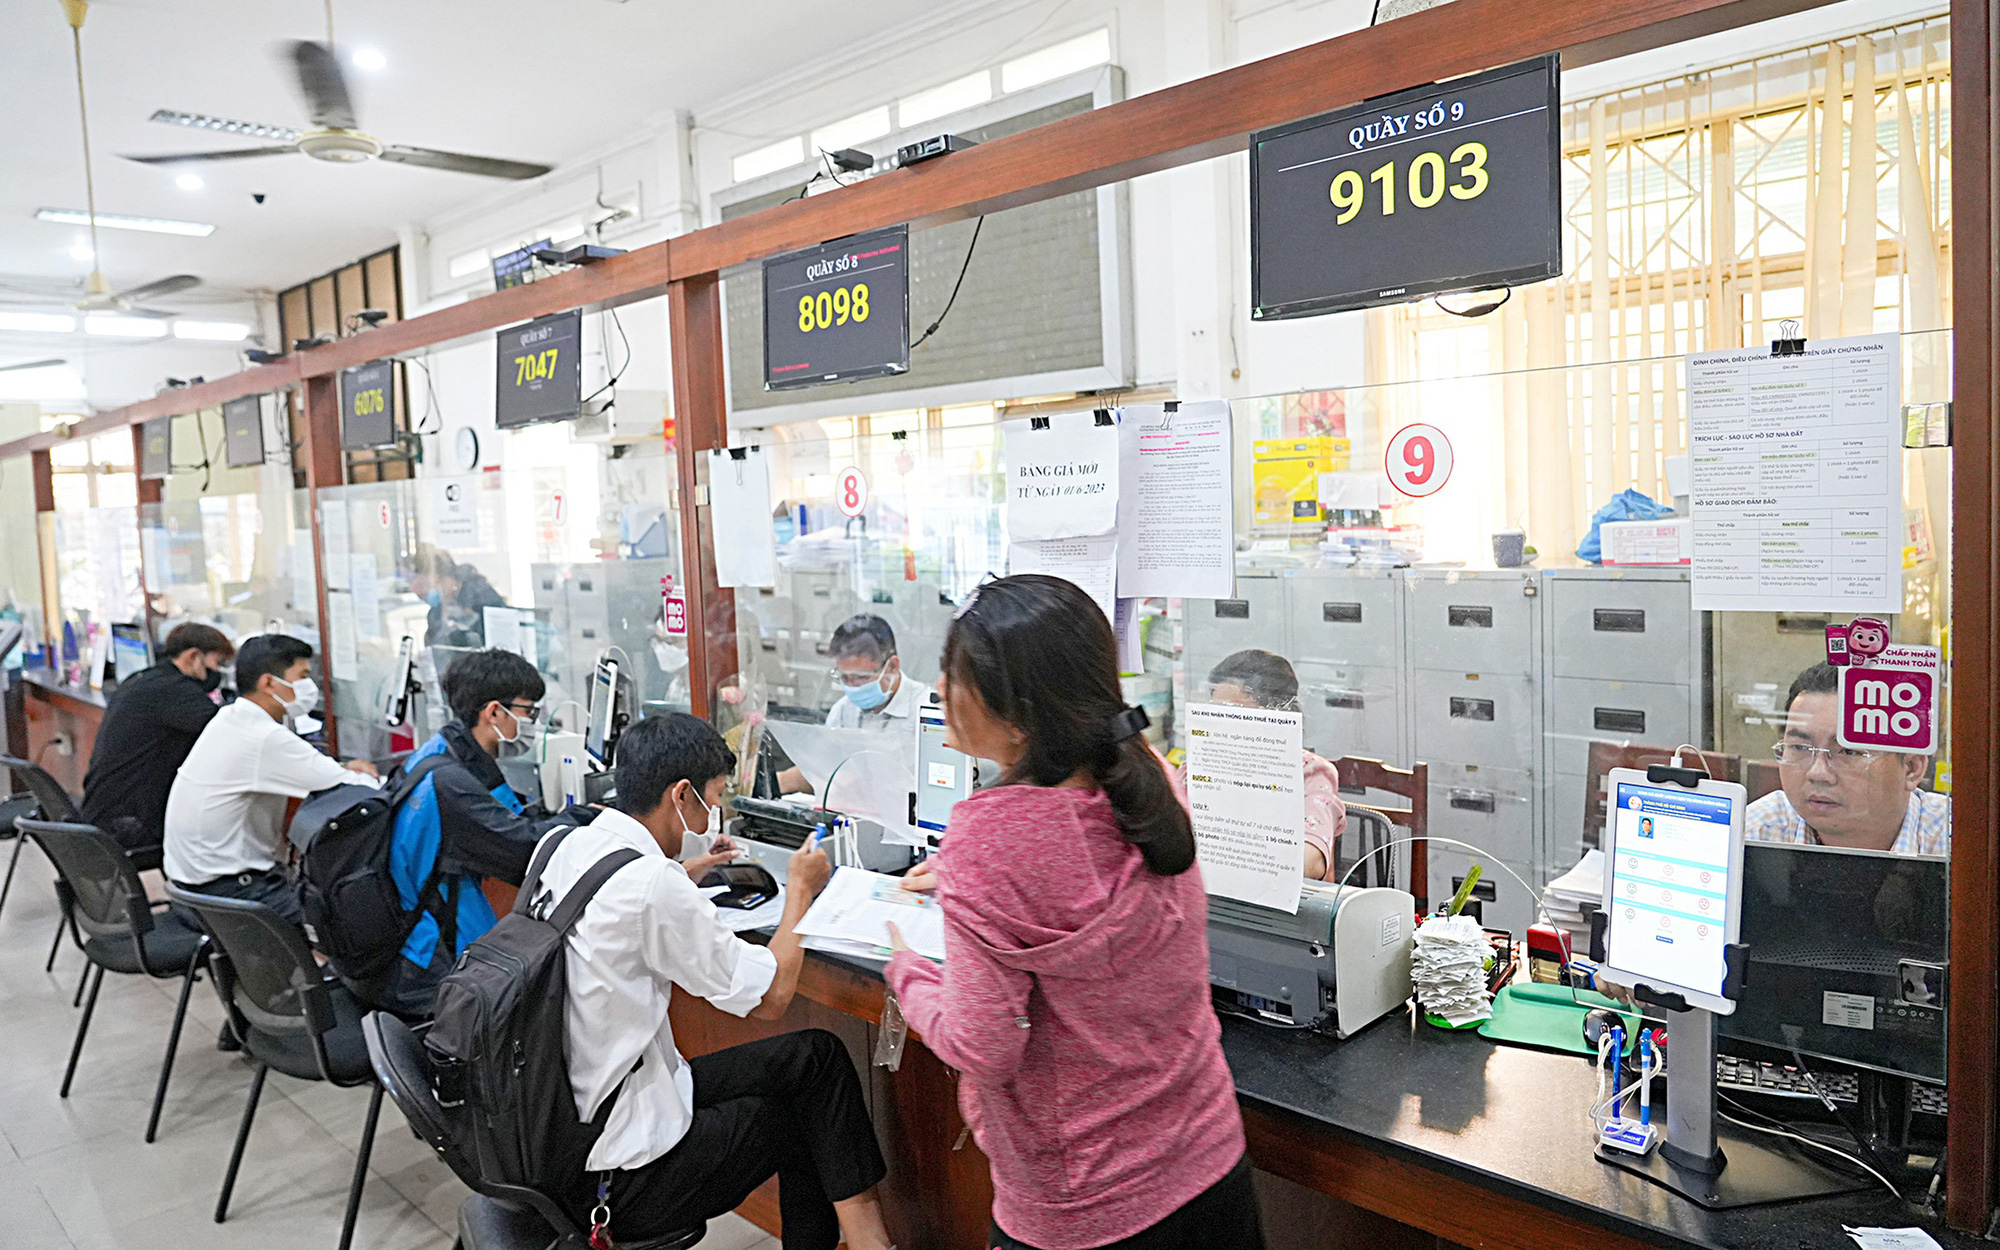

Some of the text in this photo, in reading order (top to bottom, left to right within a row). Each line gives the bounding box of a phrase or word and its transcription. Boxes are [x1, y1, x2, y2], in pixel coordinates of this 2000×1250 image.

[1348, 101, 1465, 149] QUẦY SỐ 9
[1329, 141, 1489, 226] 9103
[806, 253, 859, 282] QUẦY SỐ 8
[1379, 288, 1406, 297] SAMSUNG
[798, 283, 870, 333] 8098
[1820, 347, 1836, 355] GIẤY
[1837, 345, 1862, 354] CHỨNG
[1863, 344, 1884, 352] NHẬN
[514, 349, 558, 386] 7047
[1790, 429, 1803, 437] ĐẤT
[1076, 460, 1099, 475] MỚI
[1402, 435, 1435, 485] 9
[844, 475, 859, 509] 8
[1017, 484, 1034, 499] TỪ
[1034, 484, 1061, 498] NGÀY
[554, 495, 562, 520] 7
[1880, 658, 1936, 668] THANH TOÁN
[1885, 648, 1936, 659] CHẤP NHẬN
